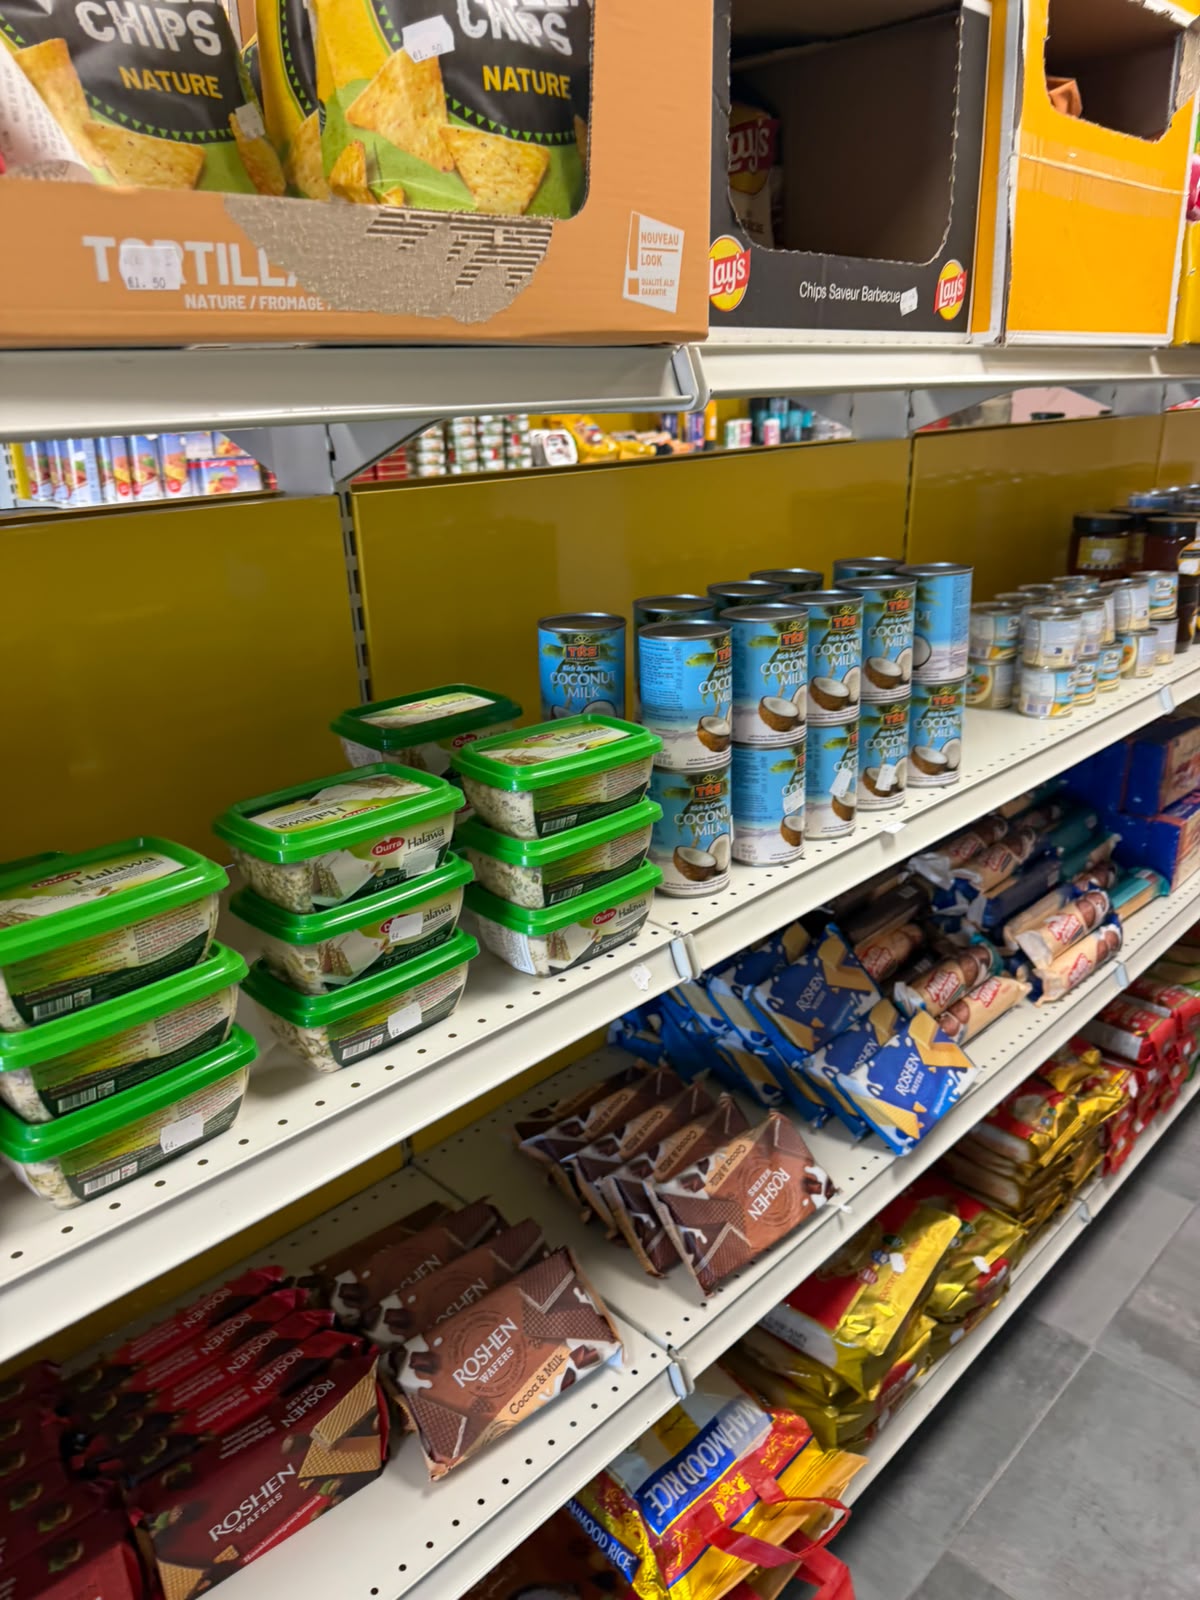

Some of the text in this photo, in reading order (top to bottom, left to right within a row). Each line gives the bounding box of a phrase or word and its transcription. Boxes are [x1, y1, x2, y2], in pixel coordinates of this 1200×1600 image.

[75, 1, 222, 56] CHIPS
[118, 66, 223, 99] NATURE
[482, 65, 572, 99] NATURE
[641, 232, 679, 246] NOUVEAU
[641, 254, 662, 267] LOOK
[709, 252, 746, 295] Lay's
[185, 294, 246, 309] NATURE
[259, 296, 325, 311] FROMAGE
[799, 281, 827, 303] Chips
[829, 283, 860, 301] Saveur
[861, 286, 901, 304] Barbecue
[938, 274, 965, 309] Lay's
[568, 645, 597, 658] TRS
[550, 671, 616, 686] COCONUT
[567, 686, 600, 698] MILK
[375, 828, 445, 854] Durra Halawa
[73, 857, 156, 885] Halawa
[424, 904, 452, 922] alawa
[796, 973, 825, 1012] ROSHEN
[895, 1052, 920, 1096] ROSHEN
[727, 1144, 747, 1167] Cocoa
[747, 1167, 791, 1221] ROSHEN
[183, 1288, 232, 1328] ROSHEN
[201, 1313, 252, 1355] ROSHEN
[227, 1330, 279, 1374] ROSHEN
[452, 1317, 518, 1387] ROSHEN
[252, 1348, 304, 1394] ROSHEN
[478, 1346, 515, 1384] WAFERS
[510, 1352, 566, 1415] Cocoa & Milk
[280, 1379, 336, 1427] ROSHEN
[208, 1463, 296, 1542] ROSHEN
[235, 1492, 283, 1533] WAFERS
[644, 1471, 689, 1517] RICE
[607, 1541, 632, 1571] RICE
